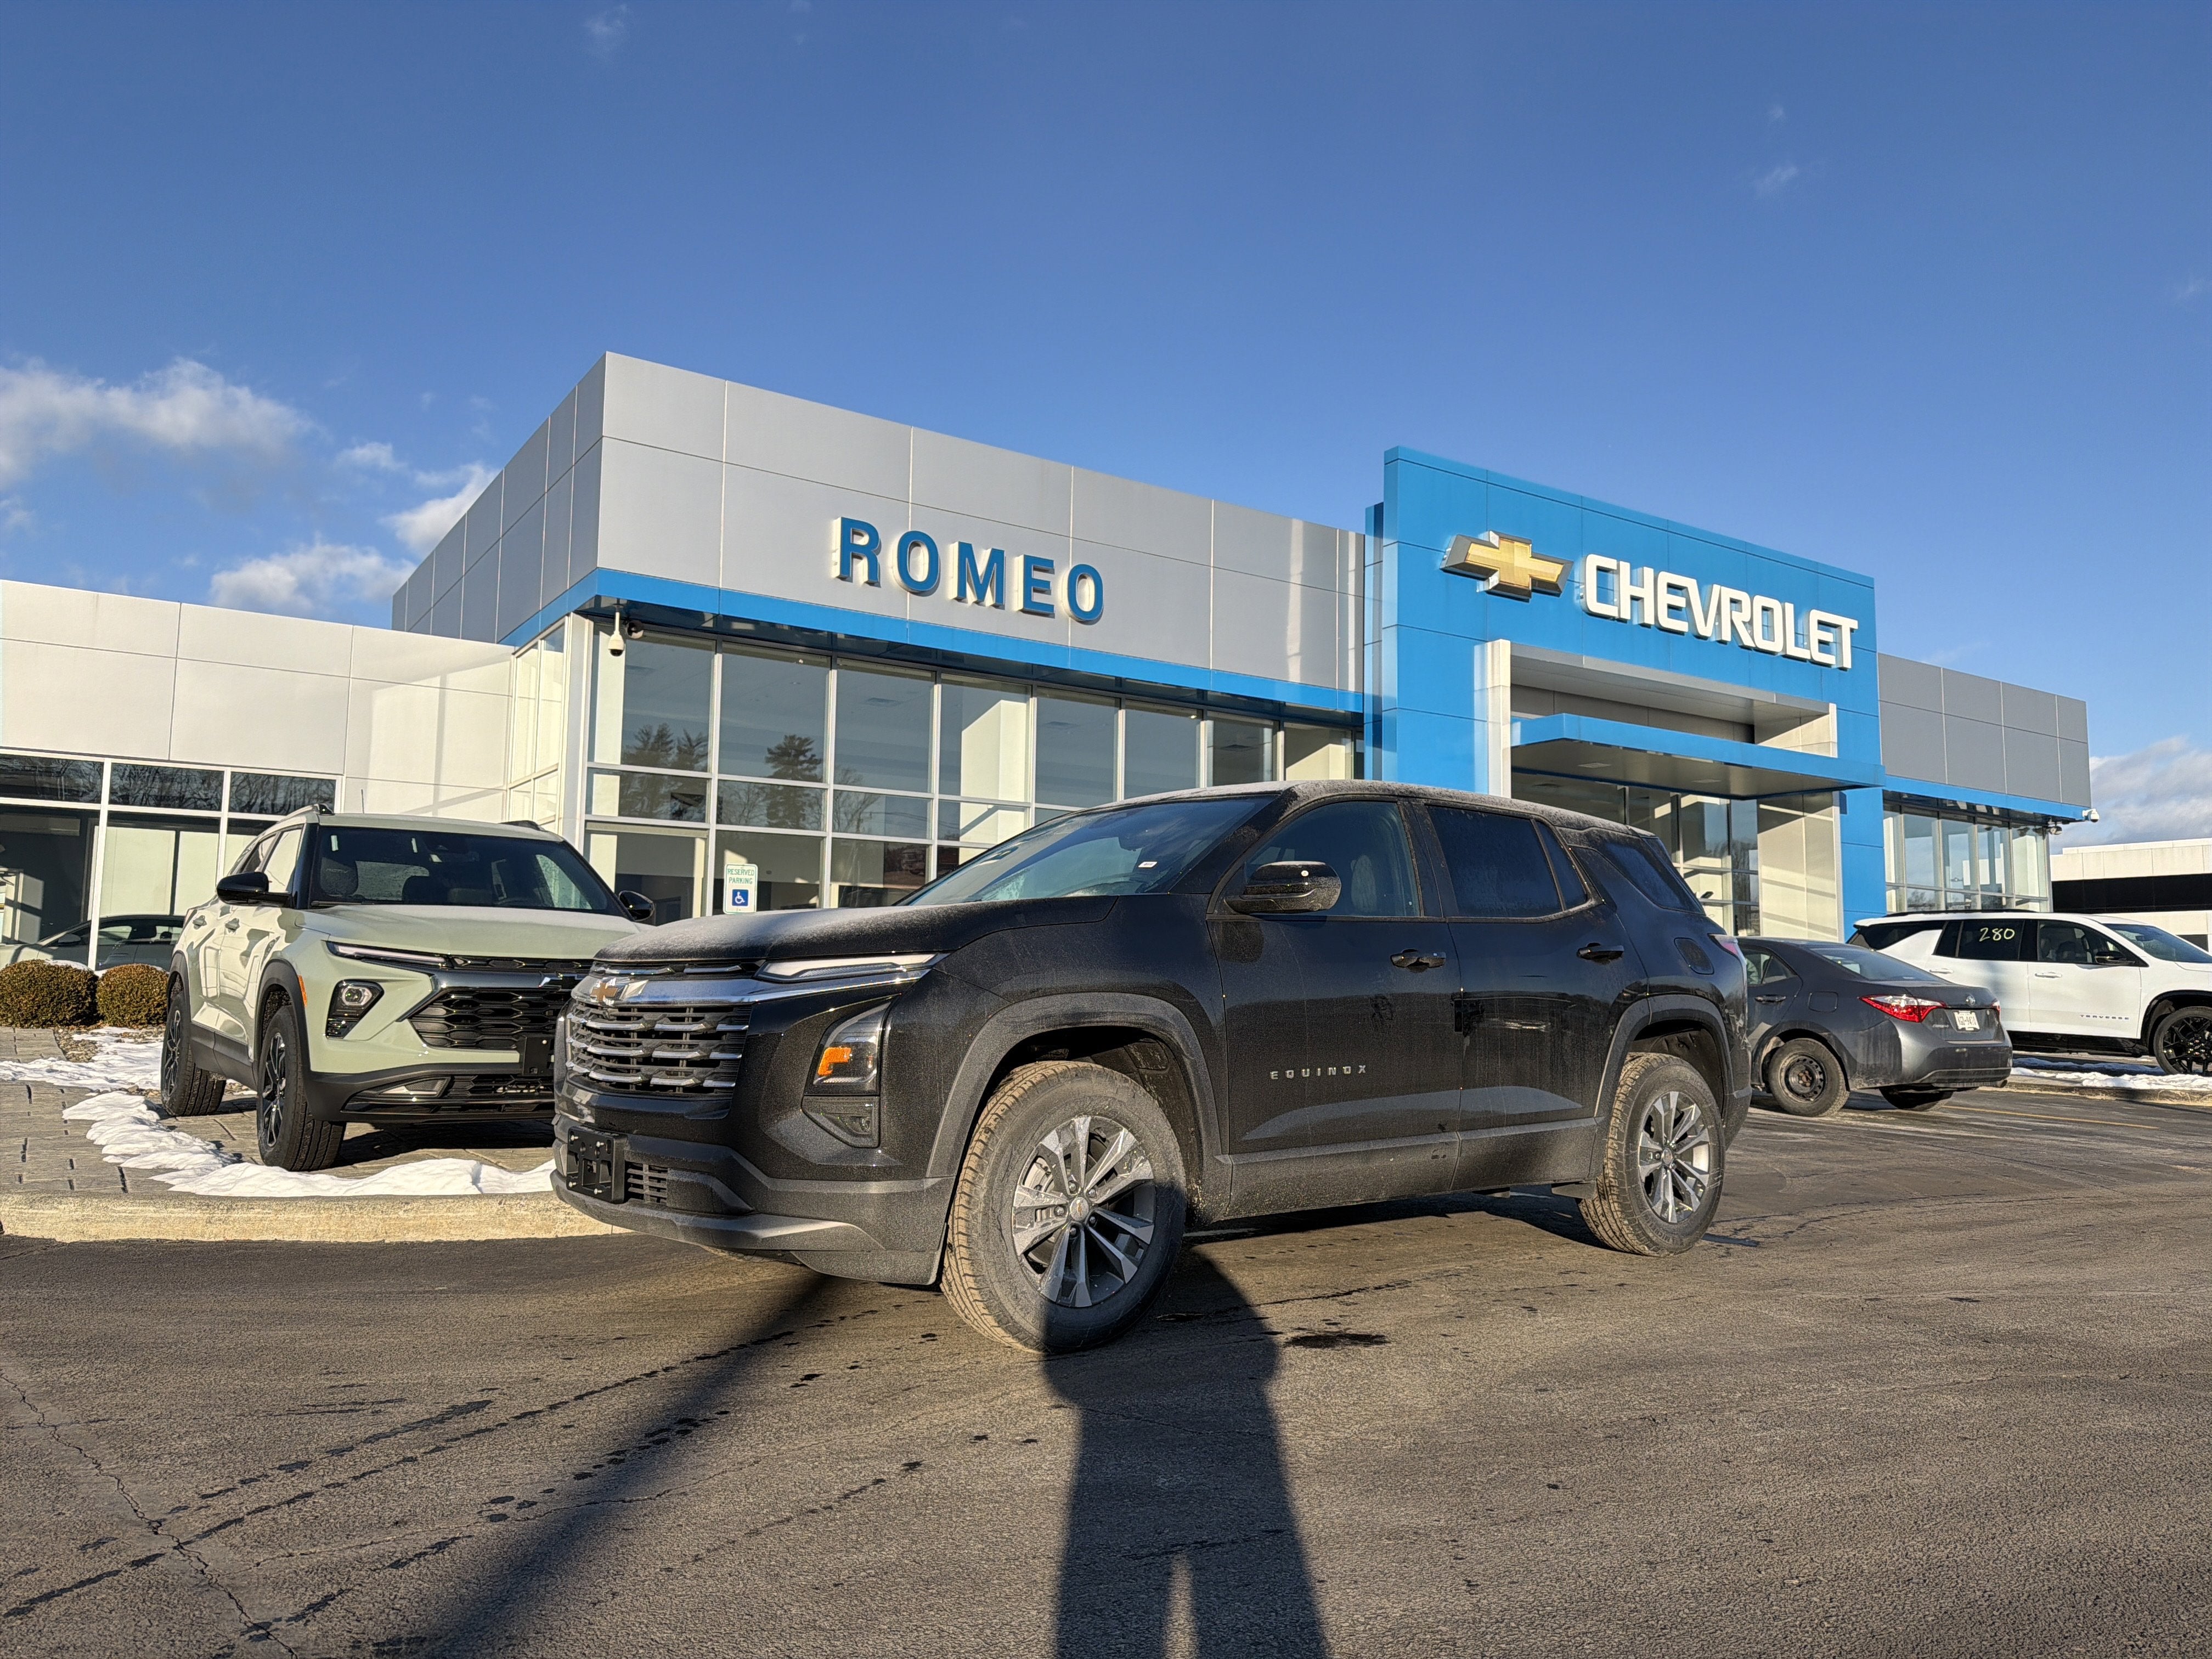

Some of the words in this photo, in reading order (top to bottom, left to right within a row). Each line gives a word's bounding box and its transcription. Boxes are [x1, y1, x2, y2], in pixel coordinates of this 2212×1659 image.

[836, 516, 1104, 623] ROMEO
[1585, 553, 1859, 670] CHEVROLET
[1979, 927, 2015, 942] 280
[1269, 1064, 1367, 1080] EQUINOX
